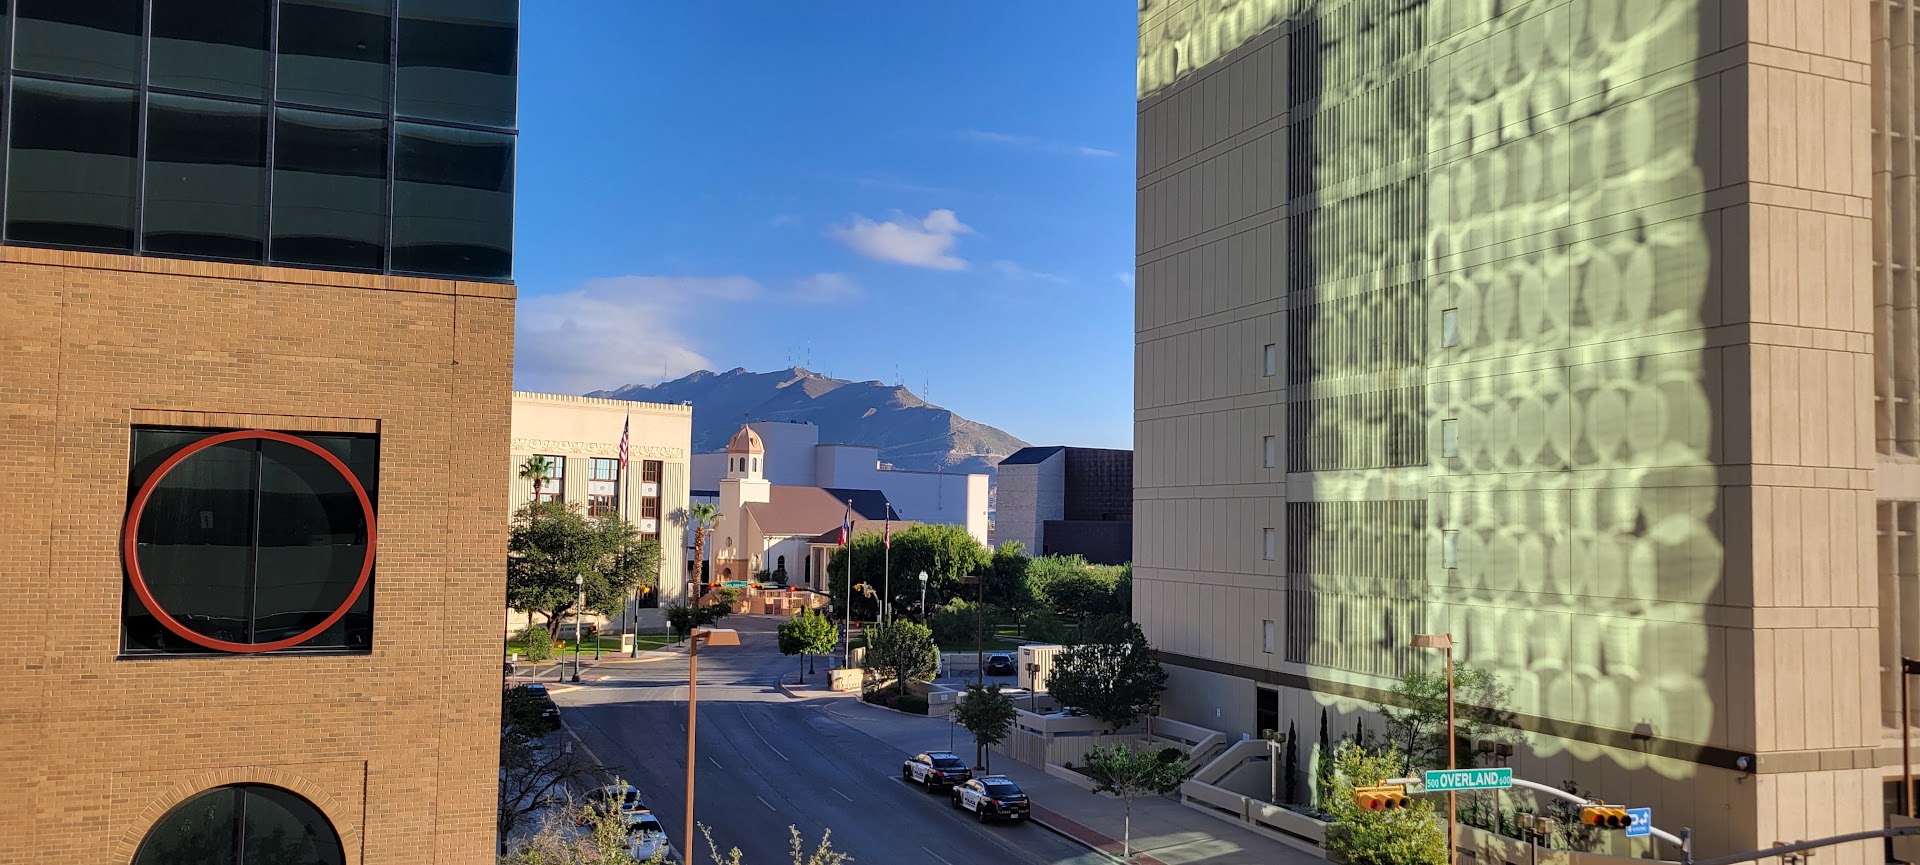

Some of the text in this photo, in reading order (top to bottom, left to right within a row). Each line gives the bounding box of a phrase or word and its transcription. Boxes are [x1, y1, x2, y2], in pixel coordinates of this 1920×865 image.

[1427, 772, 1510, 788] 500 OVERLAND 600
